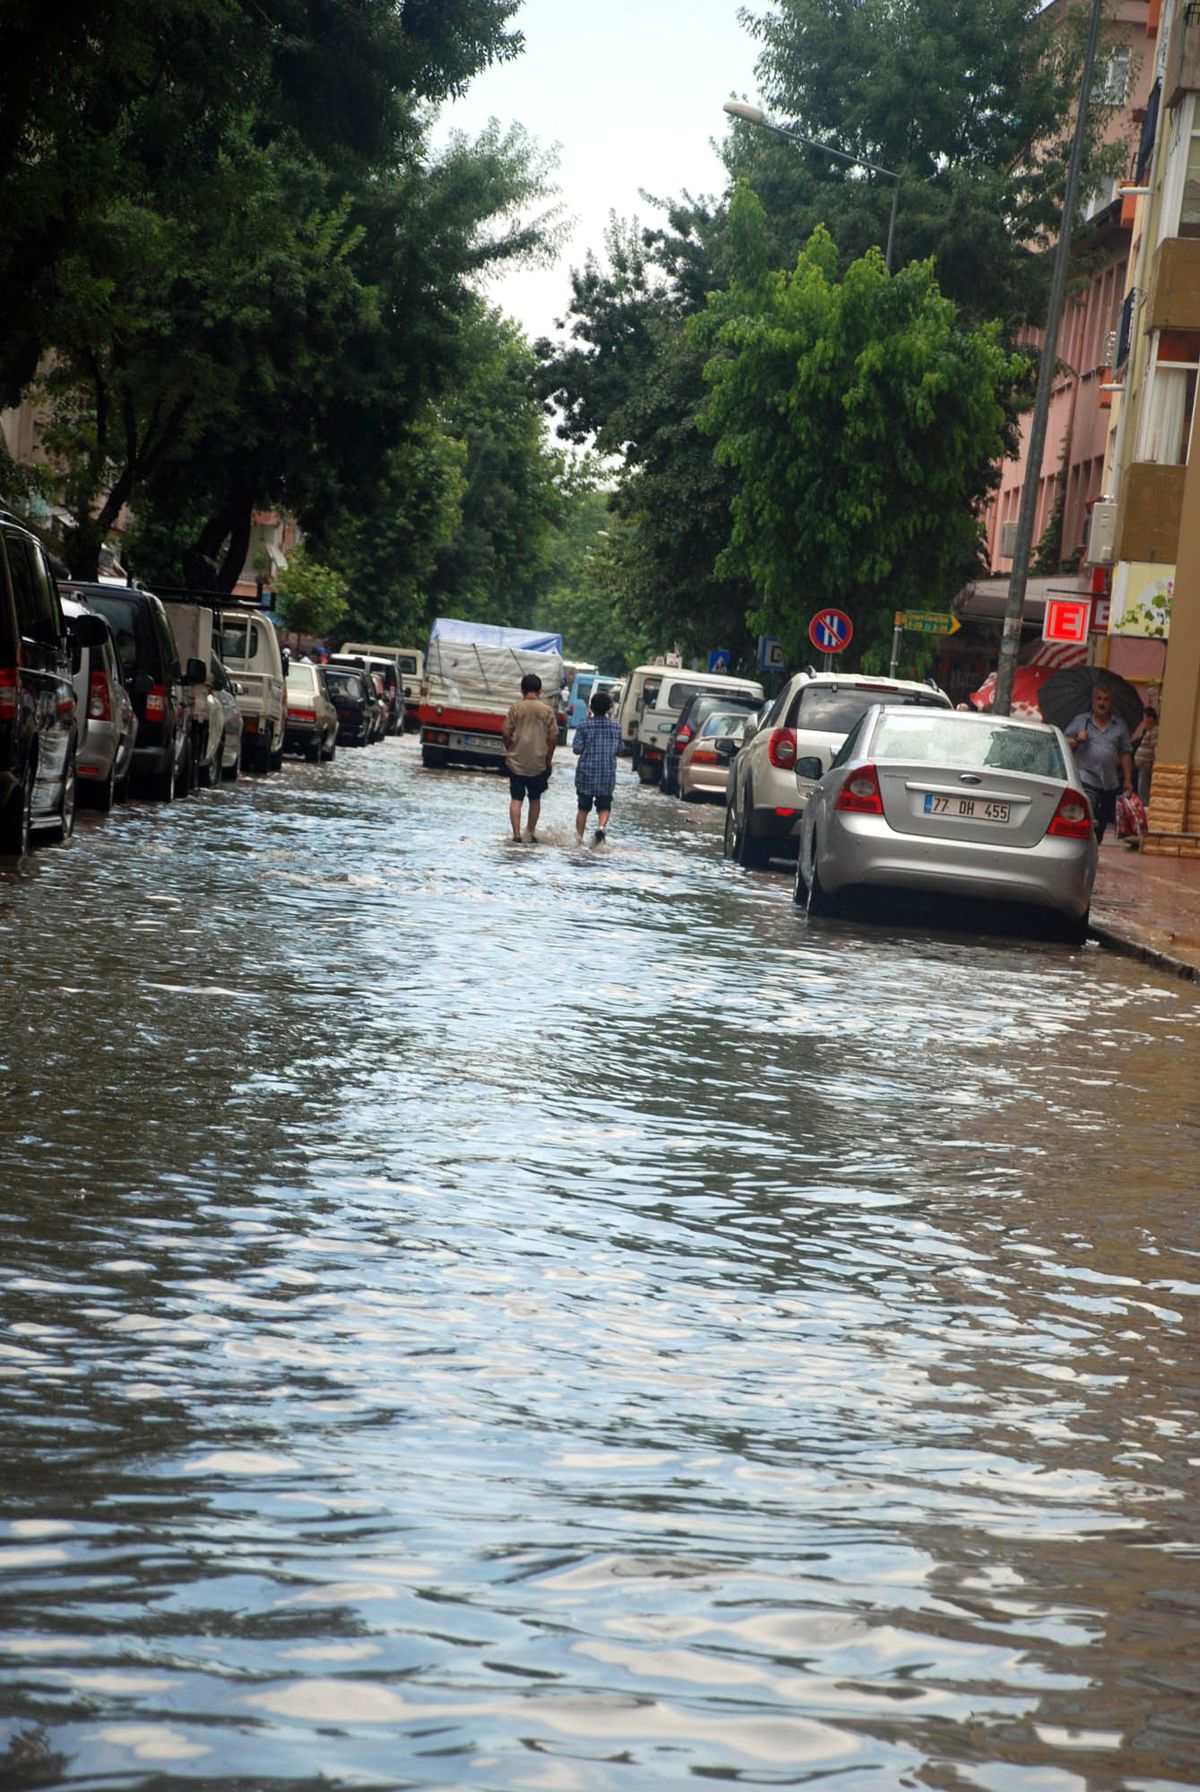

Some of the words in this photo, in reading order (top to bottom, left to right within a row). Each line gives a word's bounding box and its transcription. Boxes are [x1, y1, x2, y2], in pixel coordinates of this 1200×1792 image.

[1055, 605, 1080, 637] E
[933, 797, 949, 812] 77
[959, 800, 975, 816] DH
[984, 803, 1008, 819] 455
